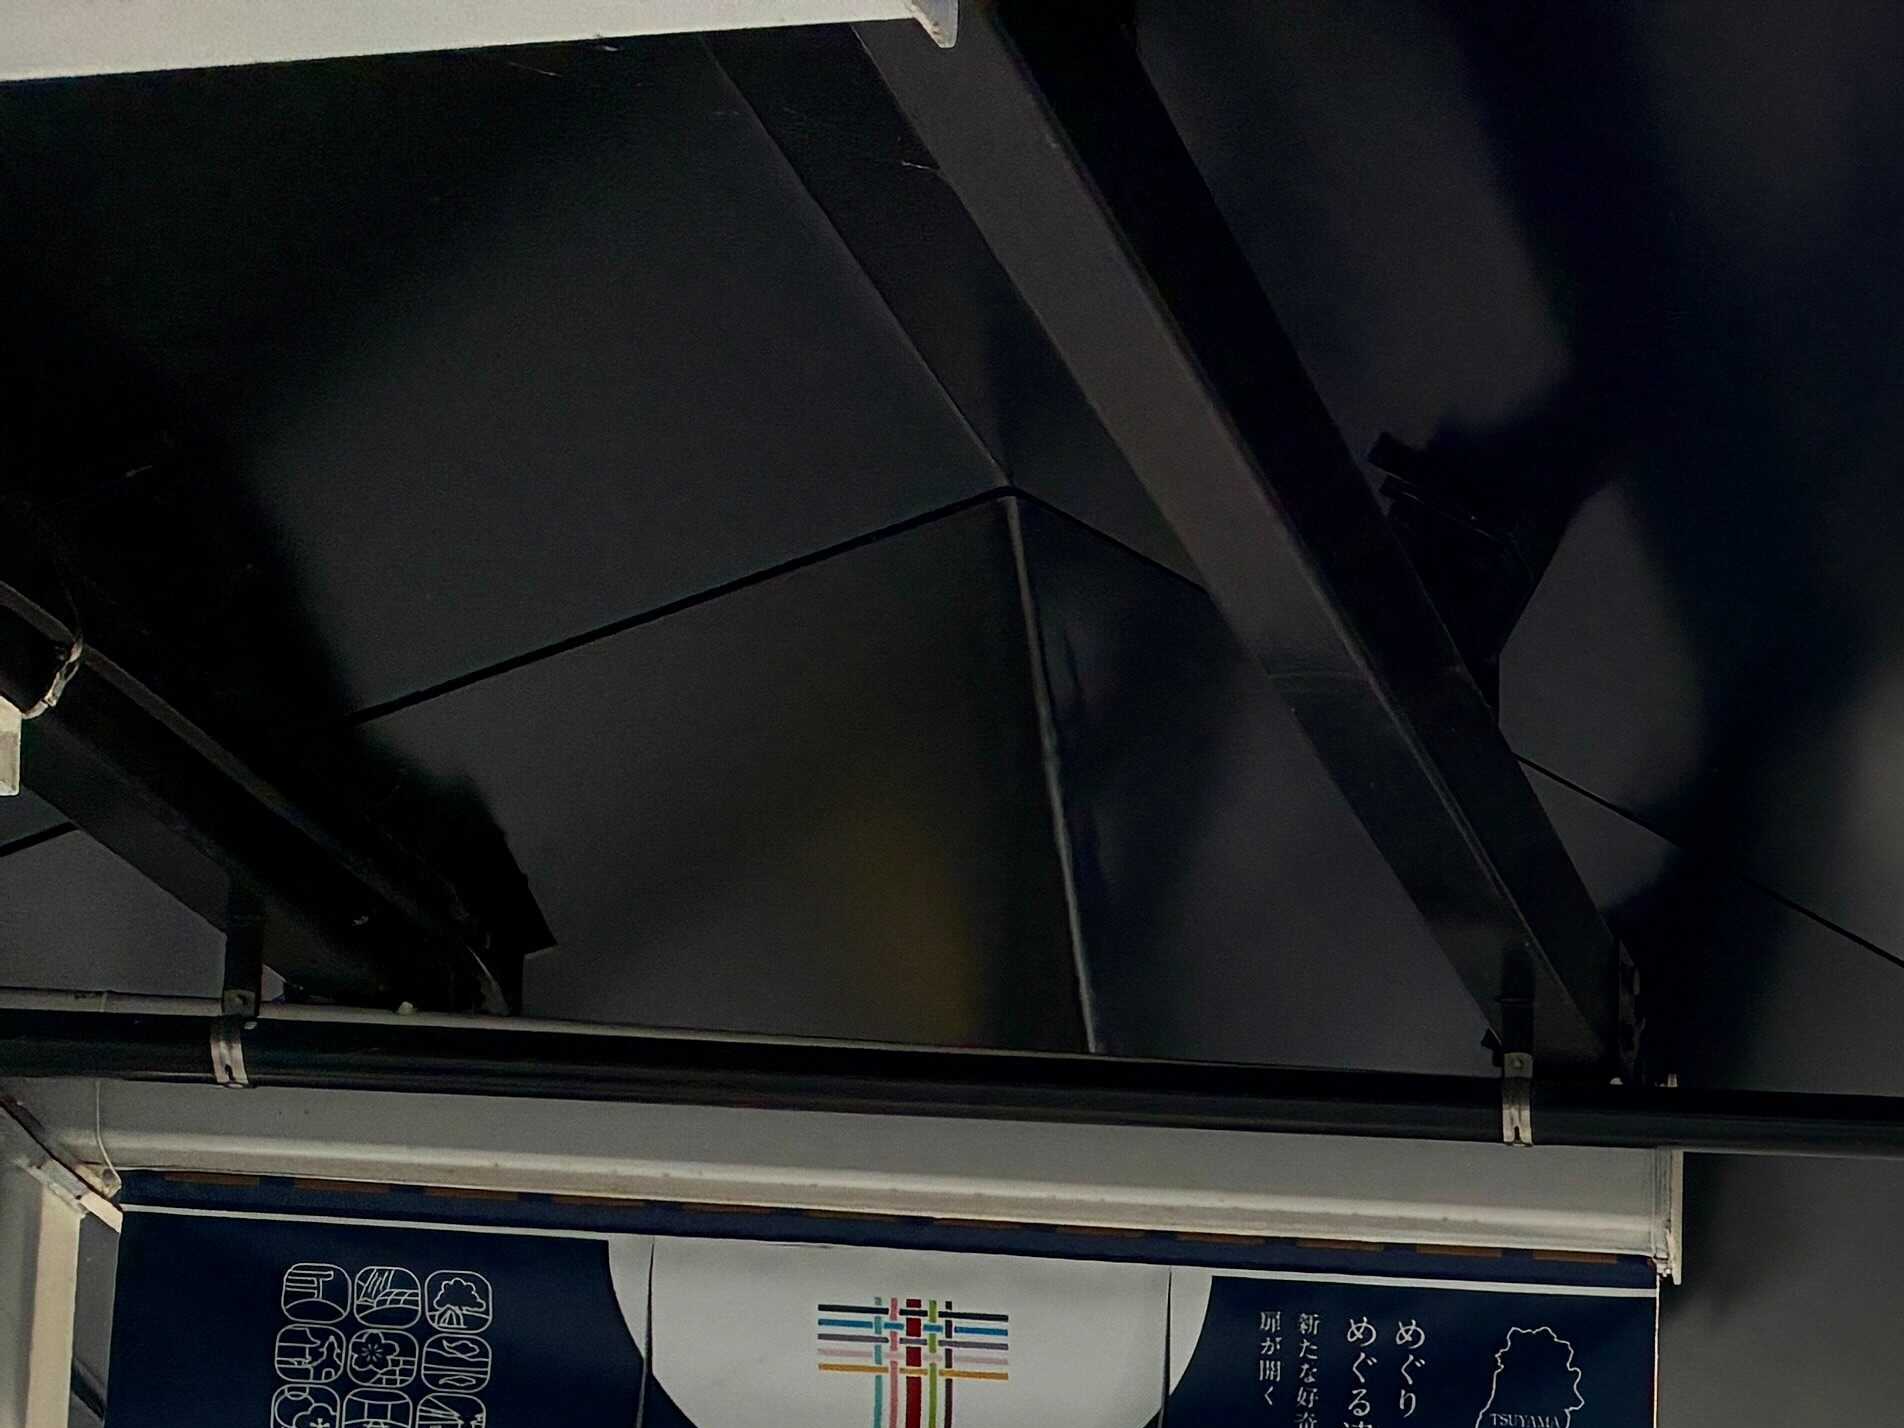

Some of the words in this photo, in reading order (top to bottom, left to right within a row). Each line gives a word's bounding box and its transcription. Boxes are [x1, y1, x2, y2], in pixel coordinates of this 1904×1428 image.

[1259, 1311, 1283, 1406] 扉が開く
[1395, 1319, 1426, 1417] めぐり
